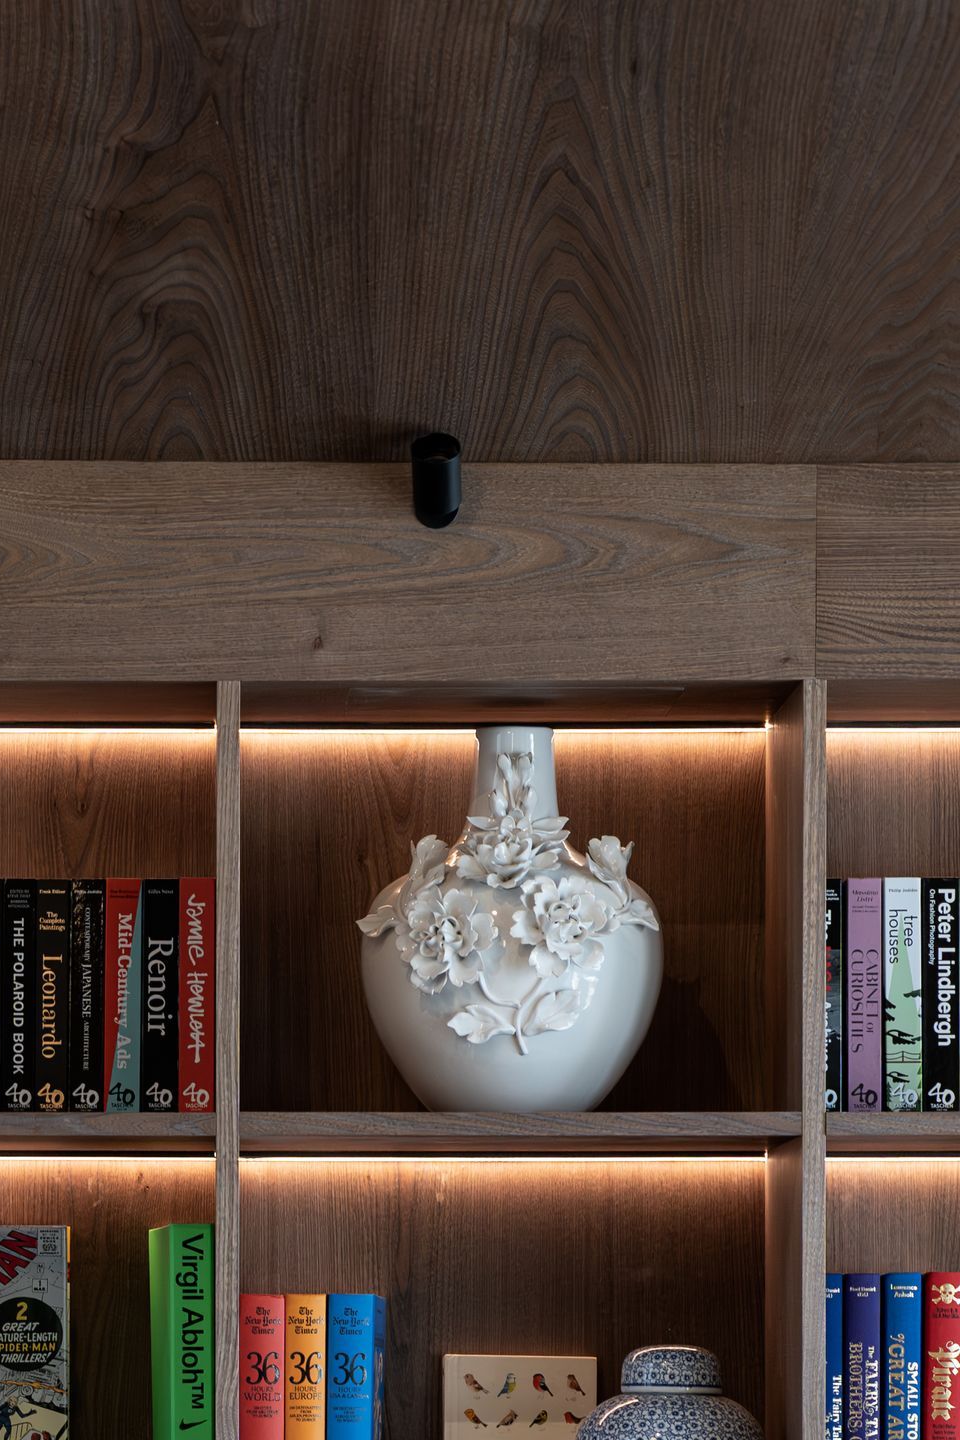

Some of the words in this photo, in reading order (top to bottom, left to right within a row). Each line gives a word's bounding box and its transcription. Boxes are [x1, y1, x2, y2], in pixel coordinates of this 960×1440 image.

[929, 889, 936, 898] On
[13, 918, 24, 947] THE
[903, 916, 918, 947] tree
[938, 888, 955, 942] Peter
[888, 909, 907, 964] houses
[928, 925, 936, 965] Photography
[13, 952, 24, 1028] POLAROID
[114, 913, 132, 1028] Mid-Century
[147, 937, 174, 1036] Renoir
[865, 949, 879, 1019] CABINET
[42, 954, 62, 1059] Leonardo
[81, 964, 92, 1018] JAPANESE
[851, 949, 864, 1053] CURIOSITIES
[934, 947, 955, 1046] Lindbergh
[13, 1033, 24, 1074] BOOK
[116, 1032, 133, 1070] Ads
[145, 1082, 173, 1104] 40
[928, 1082, 956, 1104] 40
[176, 1234, 204, 1301] Virgil
[2, 1322, 39, 1331] GREAT
[16, 1302, 28, 1320] 2
[0, 1352, 52, 1364] THRILLERS!
[246, 1351, 281, 1386] 36
[289, 1351, 323, 1386] 36
[333, 1352, 368, 1386] 36
[867, 1346, 875, 1358] The
[832, 1374, 842, 1396] The
[848, 1342, 864, 1432] BROTHERS
[888, 1343, 904, 1411] GREAT
[907, 1361, 918, 1409] SMALL
[928, 1340, 960, 1421] Pirate
[832, 1398, 842, 1424] Fairy
